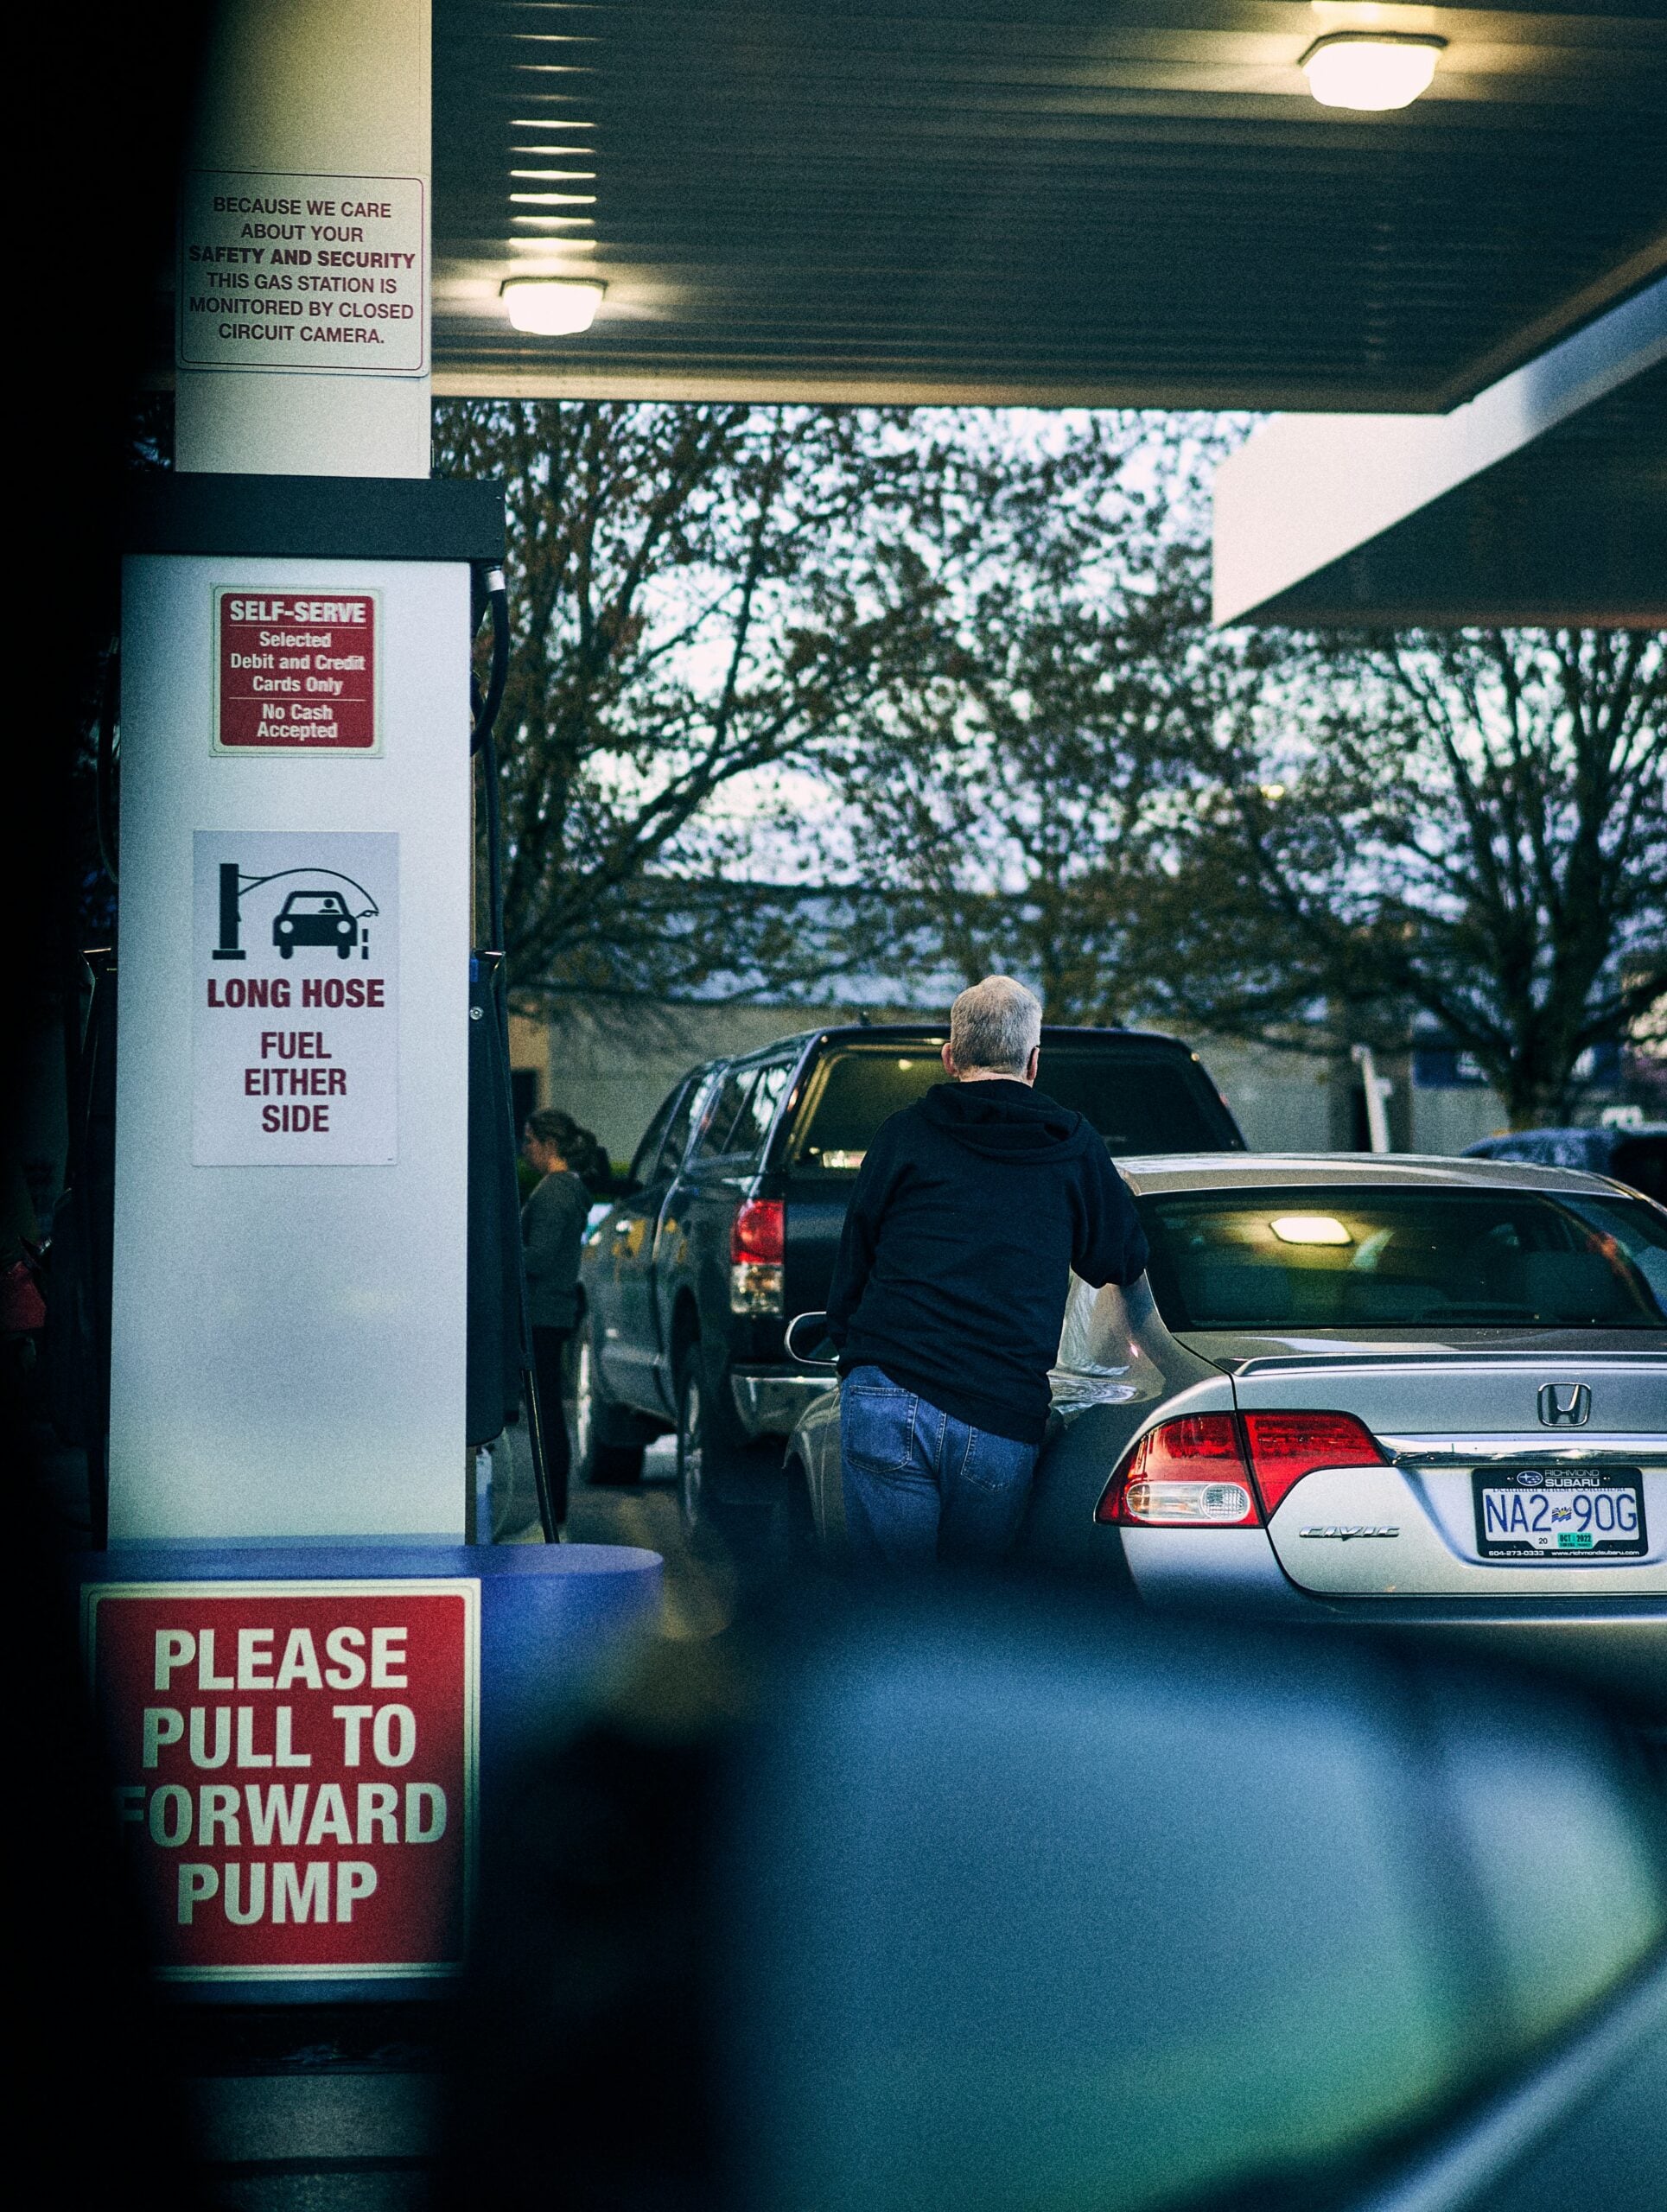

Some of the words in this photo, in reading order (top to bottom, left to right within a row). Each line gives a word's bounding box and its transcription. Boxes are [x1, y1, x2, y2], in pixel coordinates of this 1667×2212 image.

[213, 197, 301, 214] BECAUSE
[307, 200, 335, 216] WE
[340, 201, 391, 218] CARE
[240, 224, 305, 239] ABOUT
[310, 226, 363, 242] YOUR
[189, 245, 265, 264] SAFETY
[270, 249, 312, 265] AND
[317, 251, 416, 269] SECURITY
[207, 272, 249, 289] THIS
[254, 274, 292, 290] GAS
[297, 276, 373, 293] STATION
[380, 278, 397, 294] IS
[189, 297, 302, 315] MONITORED
[309, 302, 334, 316] BY
[339, 303, 414, 319] CLOSED
[219, 323, 295, 340] CIRCUIT
[300, 327, 385, 344] CAMERA.
[230, 600, 366, 623] SELF-SERVE
[259, 631, 332, 648] Selected
[231, 653, 274, 669] Debit
[279, 655, 310, 670] and
[315, 655, 366, 671] Credit
[252, 676, 301, 692] Cards
[306, 677, 343, 696] Only
[263, 703, 285, 720] No
[291, 704, 334, 720] Cash
[257, 721, 338, 741] Accepted
[207, 978, 290, 1008] LONG
[302, 978, 385, 1008] HOSE
[261, 1032, 332, 1059] FUEL
[245, 1068, 347, 1096] EITHER
[262, 1105, 329, 1133] SIDE
[1544, 1478, 1600, 1487] SUBARU
[1485, 1494, 1552, 1533] NA2
[1572, 1493, 1638, 1532] 90G
[1299, 1526, 1400, 1539] CIVIC
[1559, 1534, 1571, 1542] OCT
[1576, 1534, 1592, 1542] 2022
[154, 1626, 408, 1691] PLEASE
[143, 1706, 311, 1770] PULL
[333, 1703, 417, 1768] TO
[113, 1782, 447, 1847] FORWARD
[177, 1861, 378, 1926] PUMP
